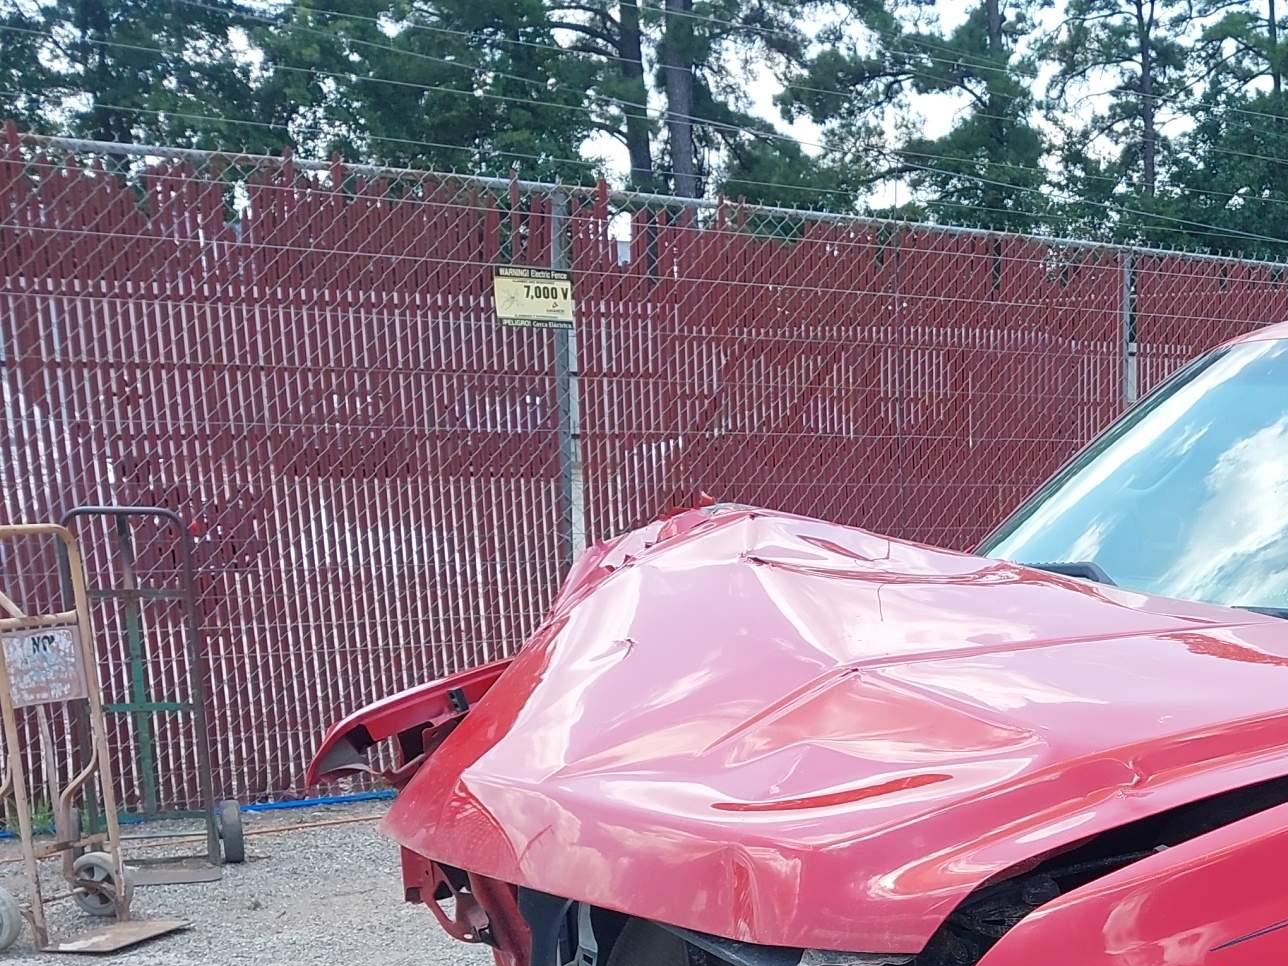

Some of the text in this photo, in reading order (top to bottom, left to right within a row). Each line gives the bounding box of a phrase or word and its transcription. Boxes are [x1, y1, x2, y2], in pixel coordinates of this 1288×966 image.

[531, 269, 551, 279] Electric
[551, 271, 568, 280] Fence
[561, 287, 569, 300] V
[532, 320, 548, 328] Cerca
